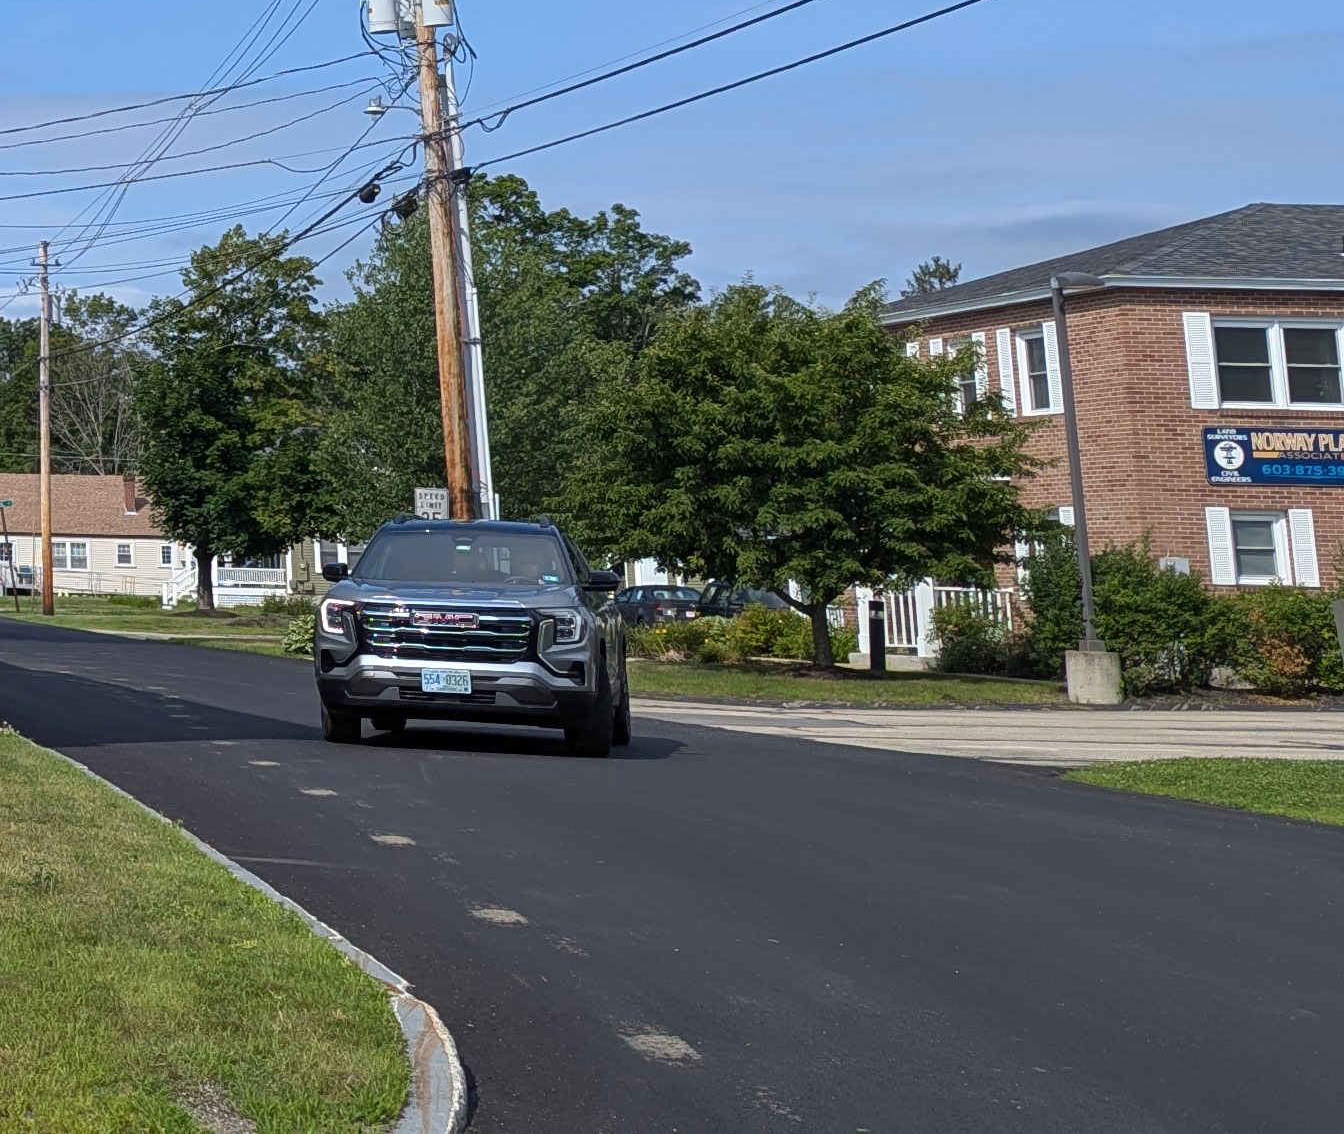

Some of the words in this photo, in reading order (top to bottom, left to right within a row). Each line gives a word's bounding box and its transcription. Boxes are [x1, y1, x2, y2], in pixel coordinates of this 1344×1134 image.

[1250, 432, 1316, 451] NORWAY
[419, 493, 445, 501] SPEED
[414, 613, 473, 626] GMC
[424, 673, 441, 685] 554
[445, 674, 469, 686] 0326
